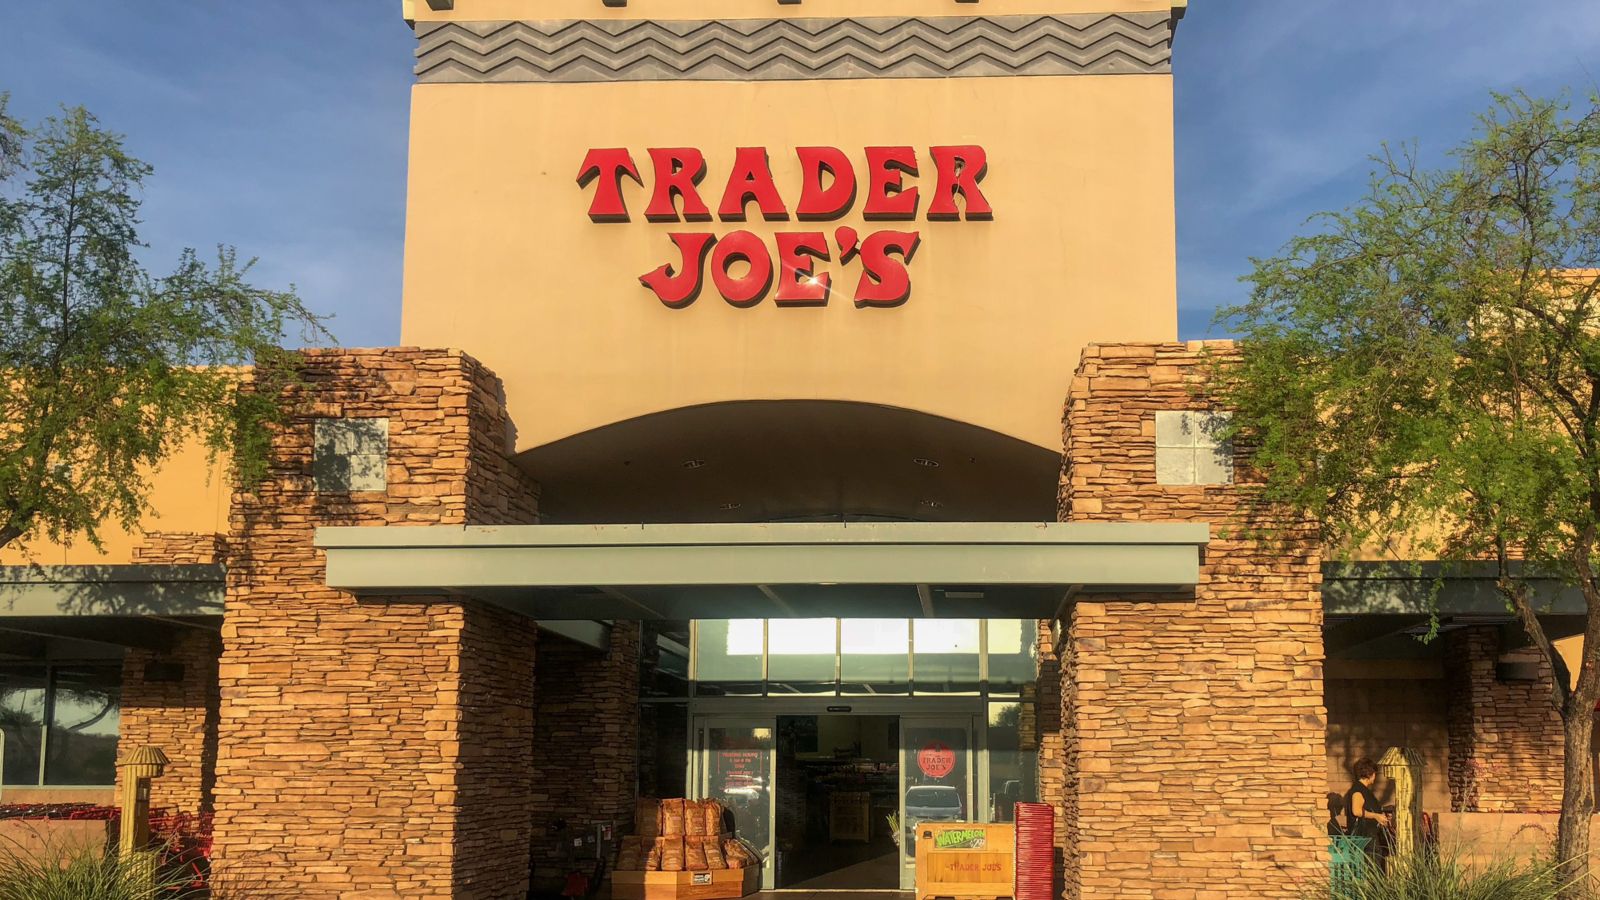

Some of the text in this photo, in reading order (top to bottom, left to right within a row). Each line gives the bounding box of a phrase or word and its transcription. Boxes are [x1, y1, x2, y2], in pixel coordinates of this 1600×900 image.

[576, 145, 993, 223] TRADER
[638, 226, 921, 309] JOE'S
[936, 829, 985, 848] WATERMELON
